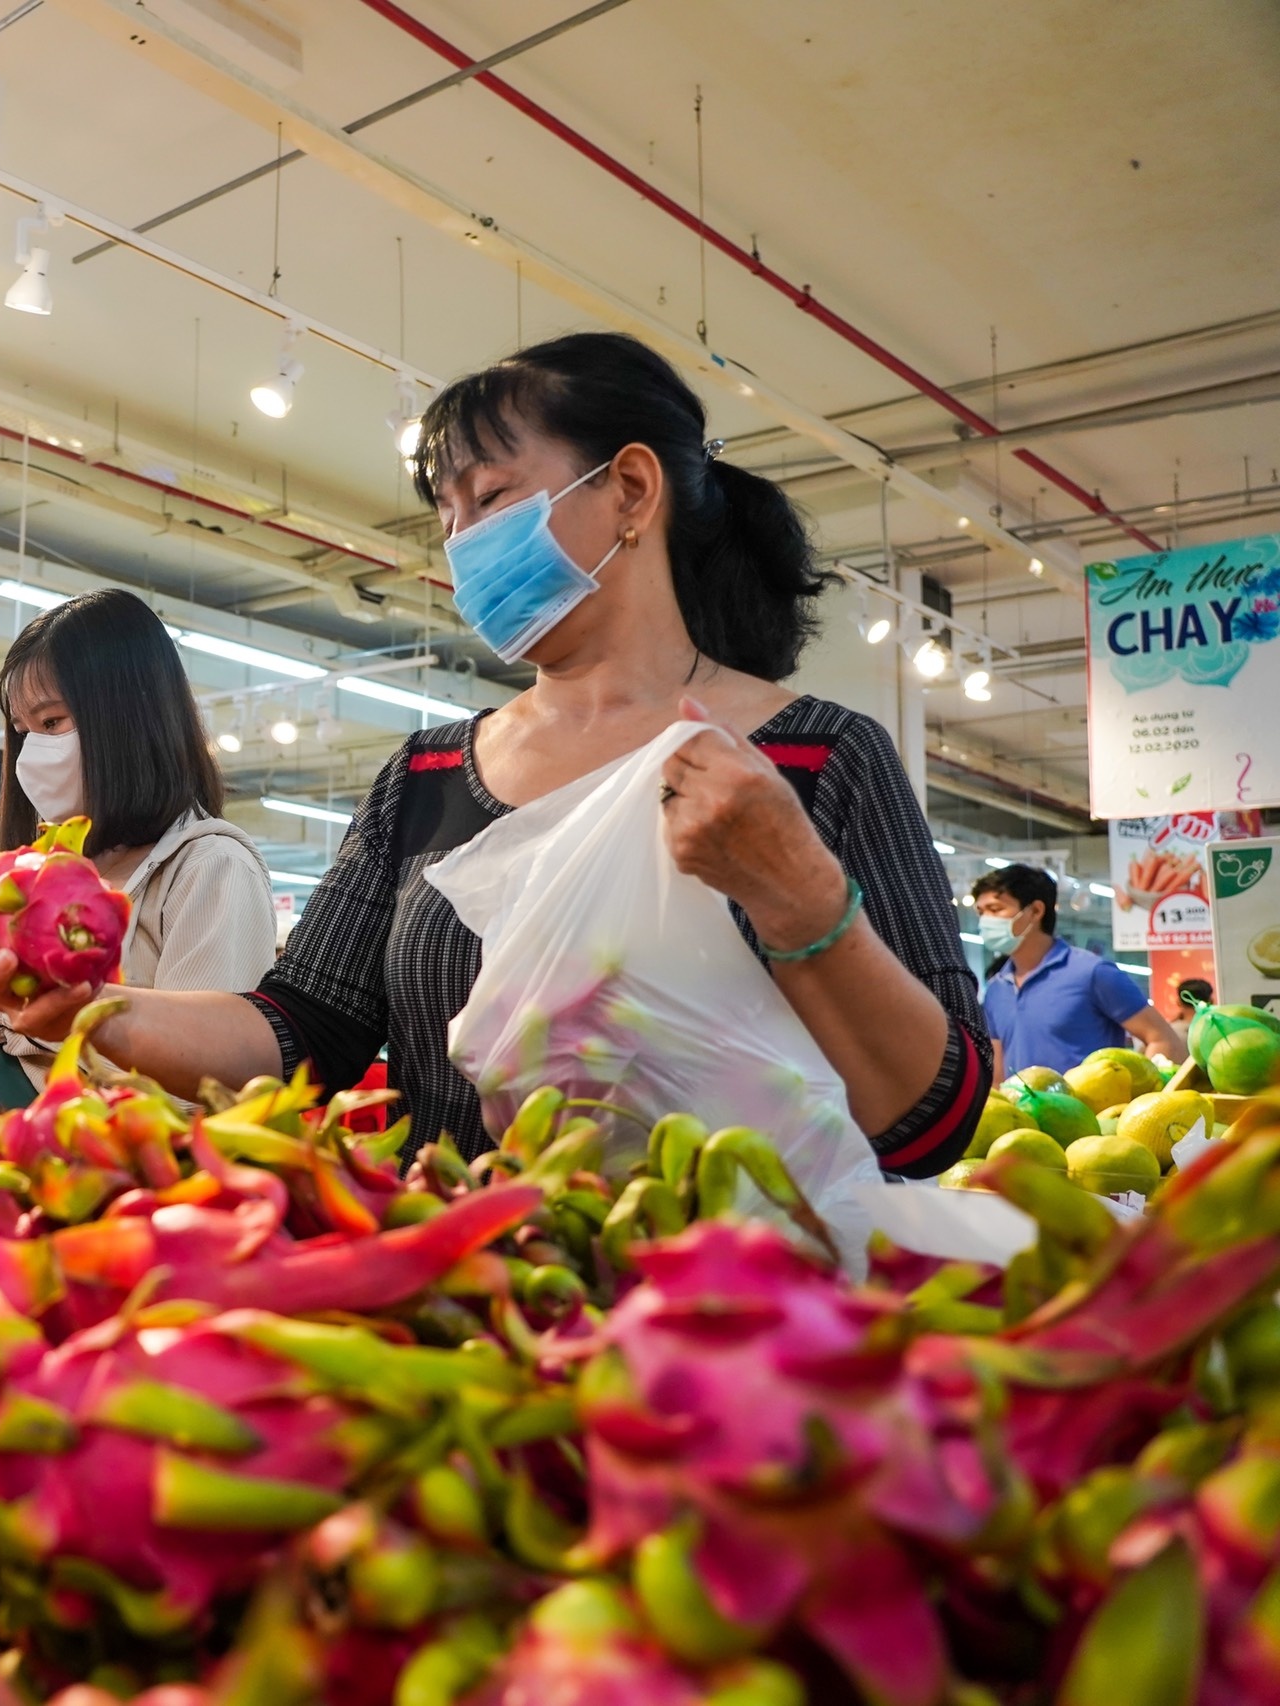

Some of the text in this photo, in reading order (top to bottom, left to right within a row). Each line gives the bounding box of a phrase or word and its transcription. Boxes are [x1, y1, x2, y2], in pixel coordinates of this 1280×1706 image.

[1107, 597, 1242, 656] CHAY
[1132, 726, 1170, 738] 06.02
[1129, 739, 1200, 754] 12.02.2020
